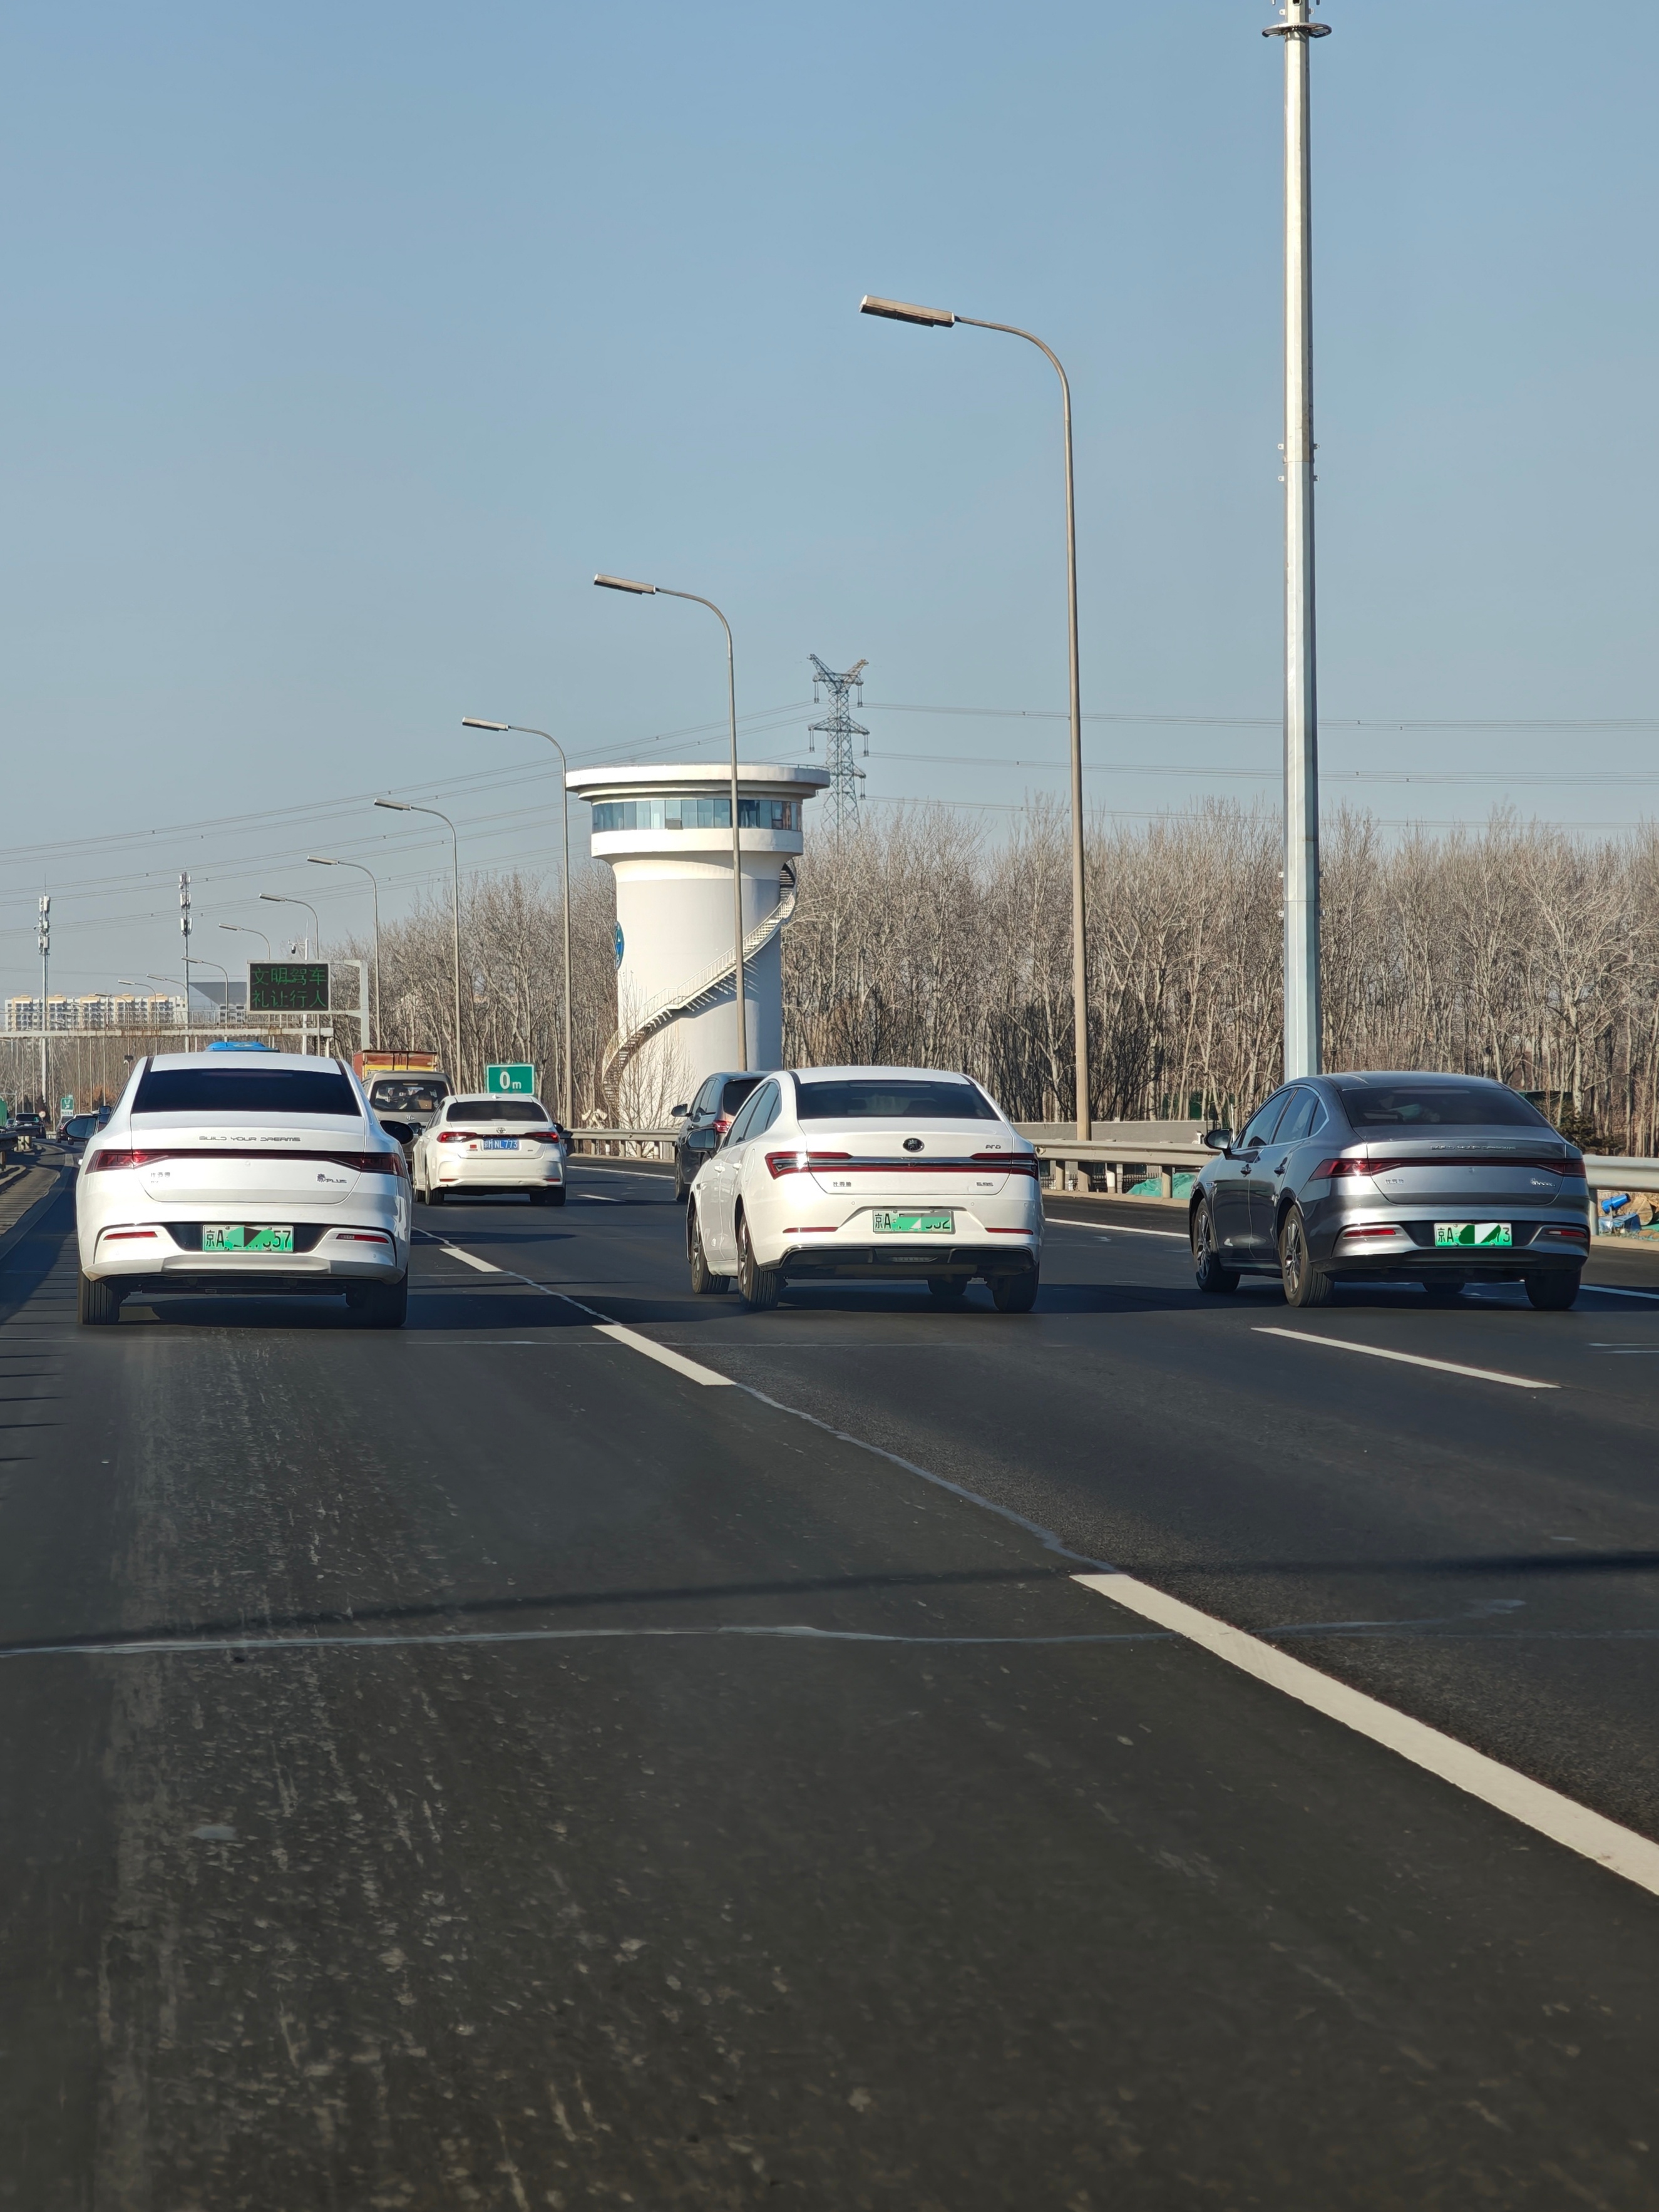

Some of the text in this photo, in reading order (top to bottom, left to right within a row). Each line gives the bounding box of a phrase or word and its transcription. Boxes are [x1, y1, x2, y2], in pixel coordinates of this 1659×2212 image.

[251, 967, 327, 985] 文明驾车
[252, 990, 326, 1008] 礼让行人
